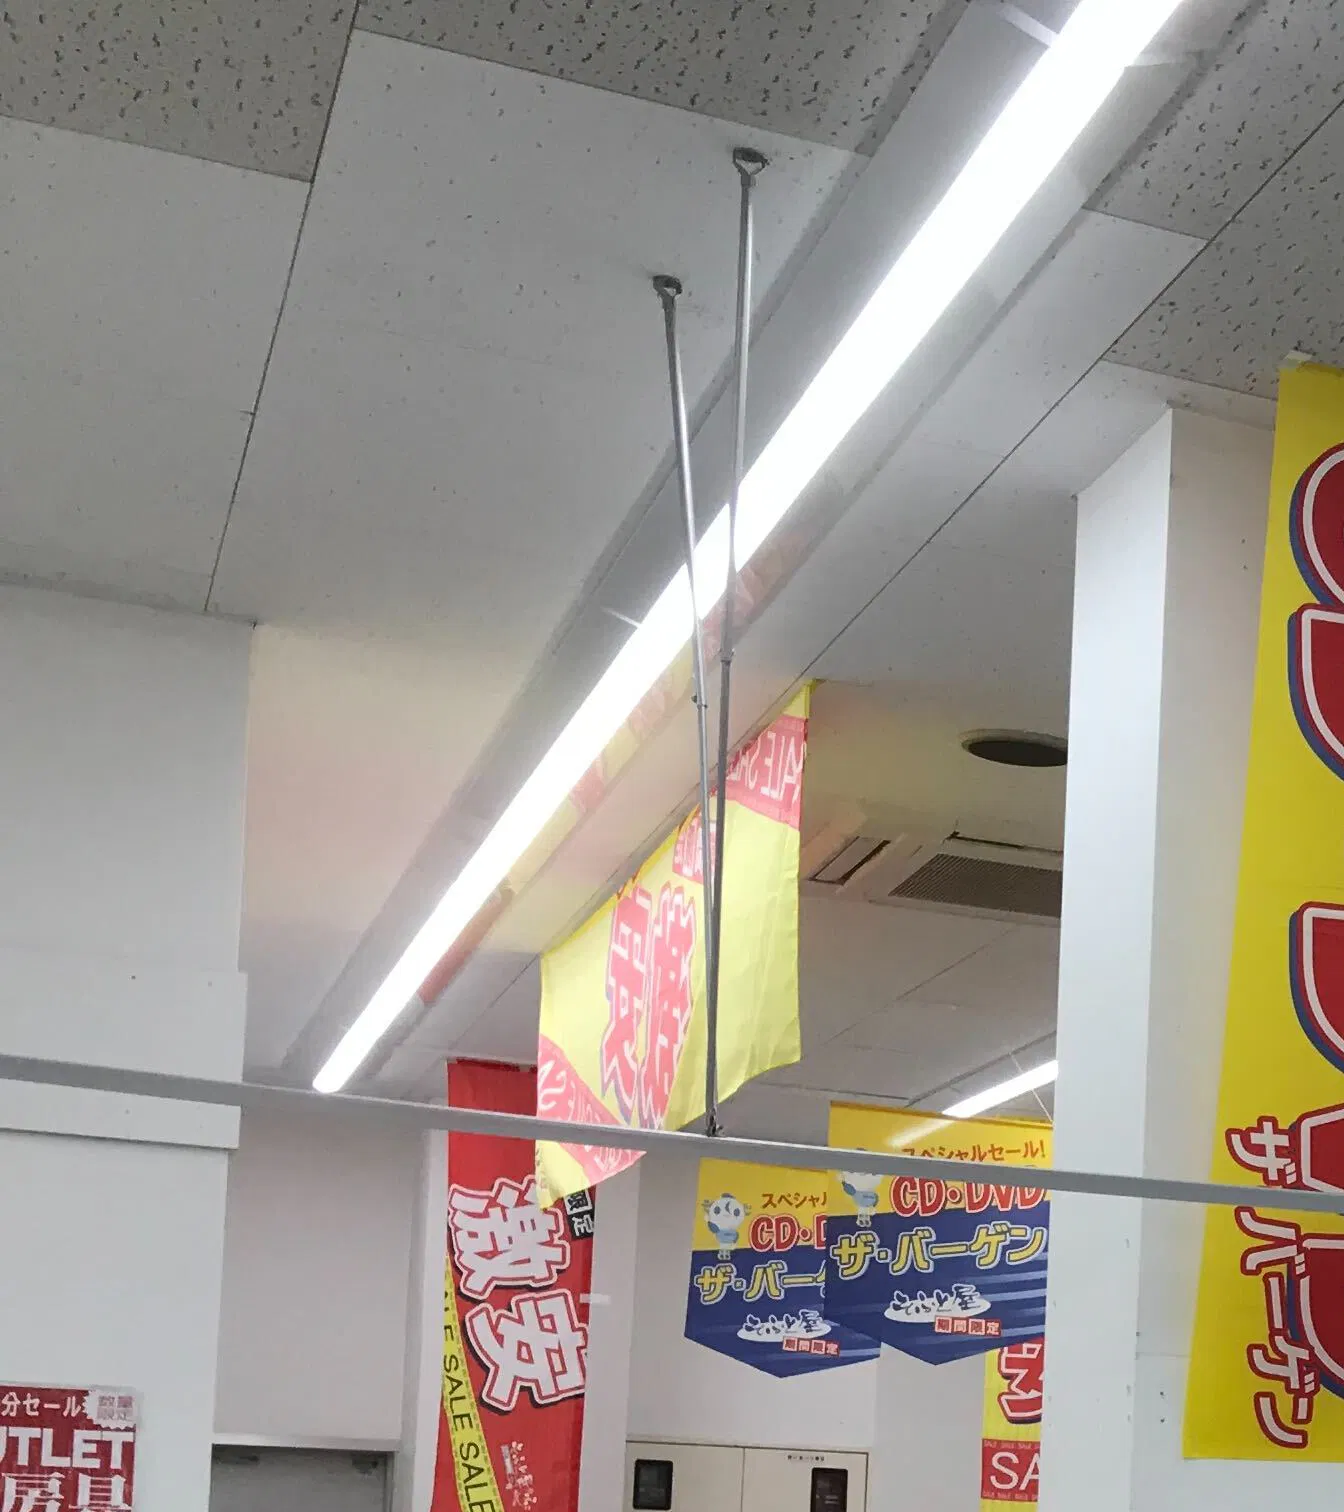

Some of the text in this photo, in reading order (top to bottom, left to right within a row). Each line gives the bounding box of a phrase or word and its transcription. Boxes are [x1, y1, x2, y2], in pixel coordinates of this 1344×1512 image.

[831, 1220, 1050, 1281] ザ・バーゲン
[695, 1259, 826, 1305] ザ・バー
[1225, 1116, 1322, 1448] ザバーゲン
[0, 1426, 134, 1469] TLET
[990, 1451, 1041, 1490] SA
